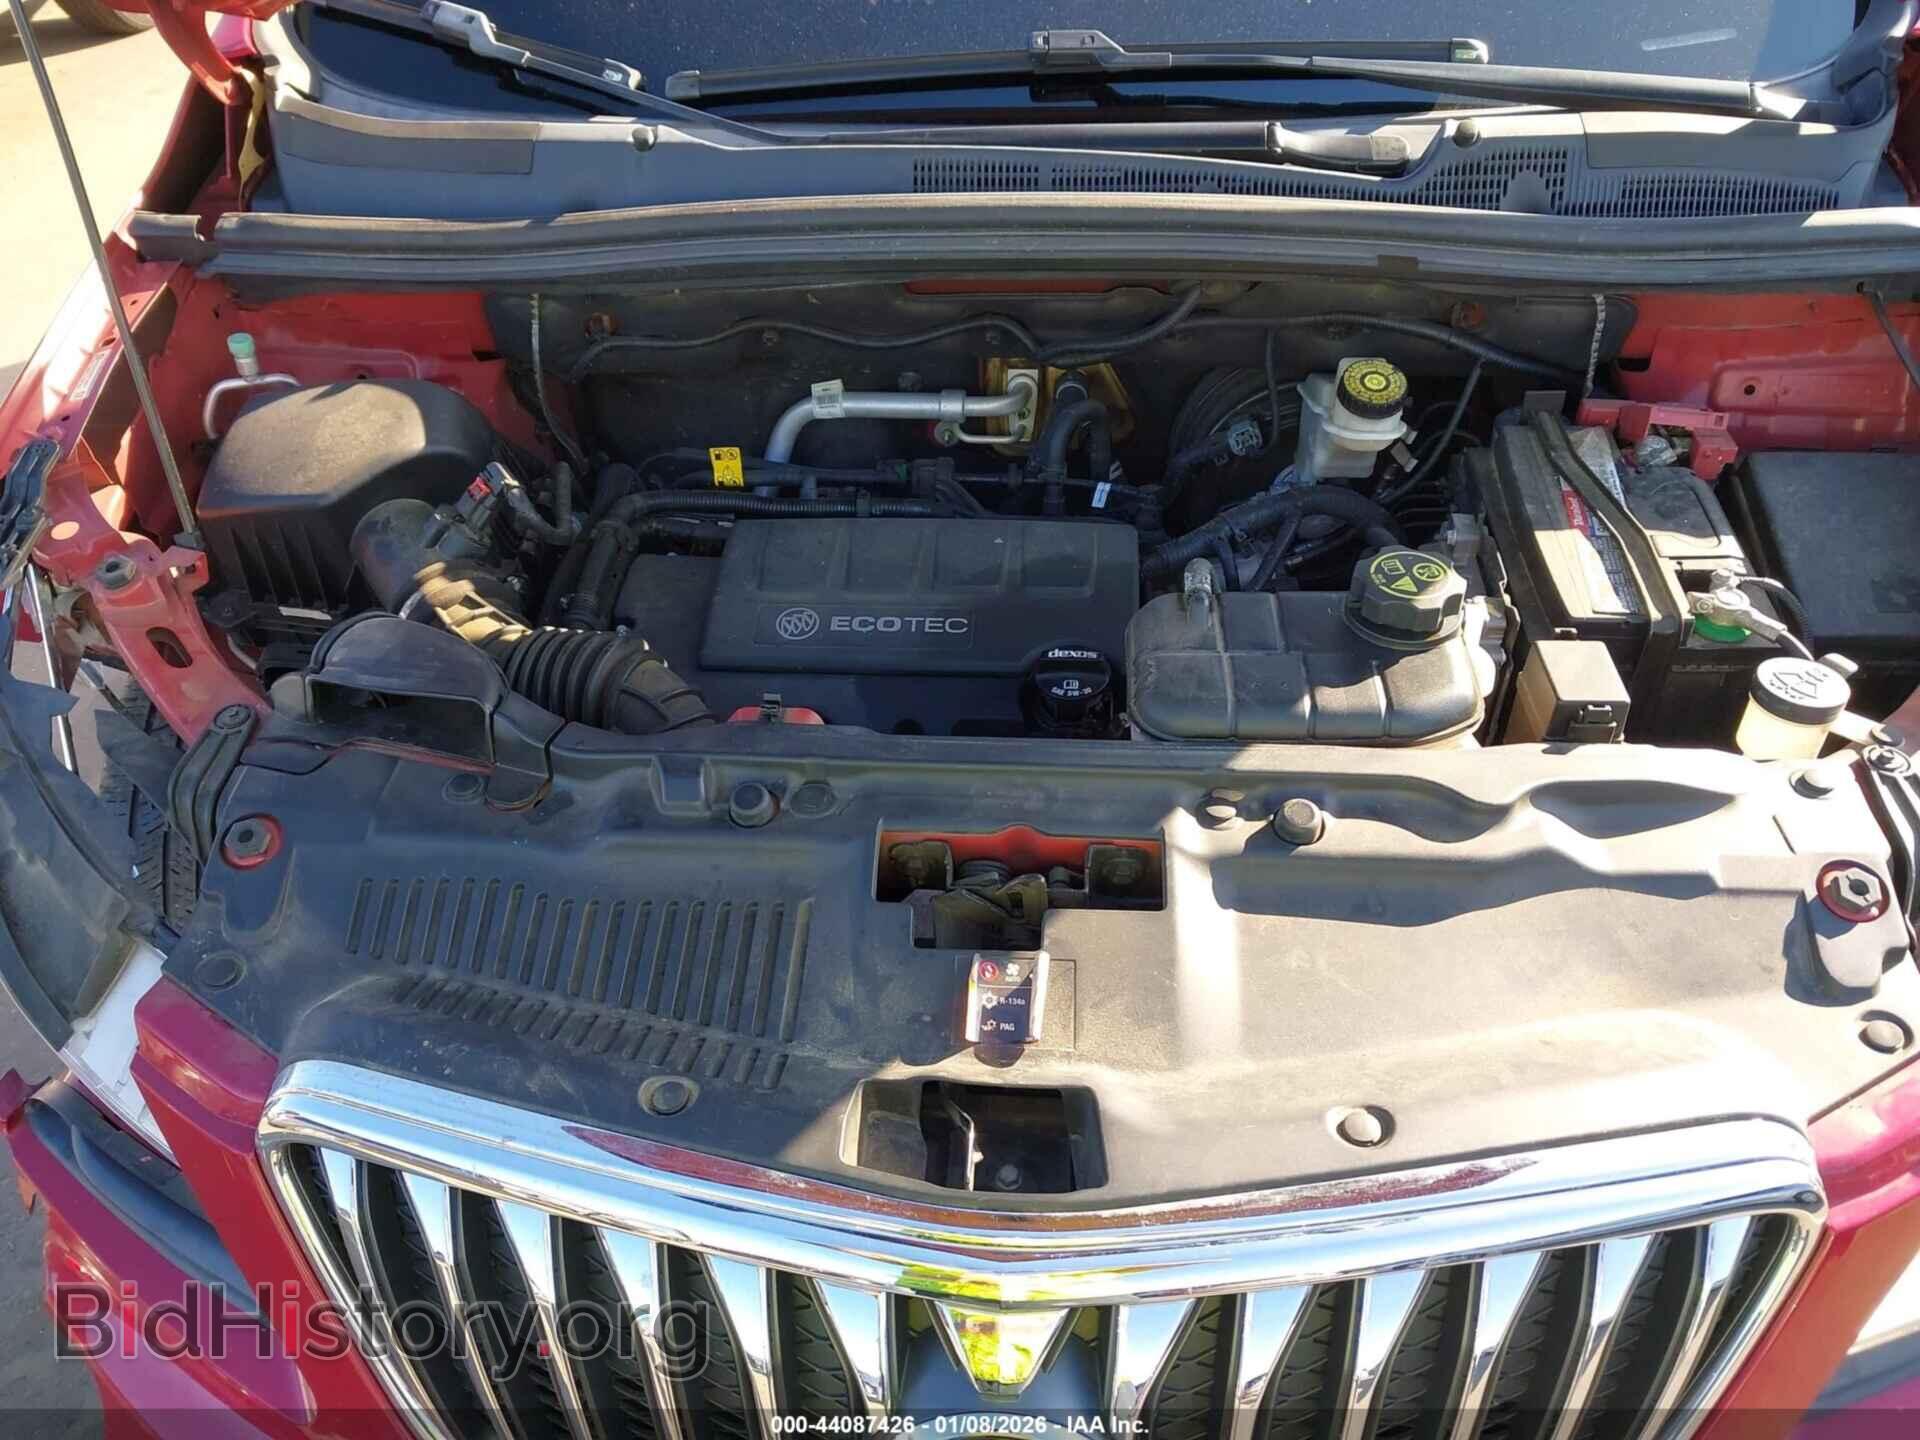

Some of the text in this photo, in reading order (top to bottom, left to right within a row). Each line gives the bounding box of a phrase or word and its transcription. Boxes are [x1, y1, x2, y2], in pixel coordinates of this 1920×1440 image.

[830, 616, 968, 633] ECOTEC
[1047, 648, 1098, 658] dexos
[999, 1022, 1016, 1032] PAG
